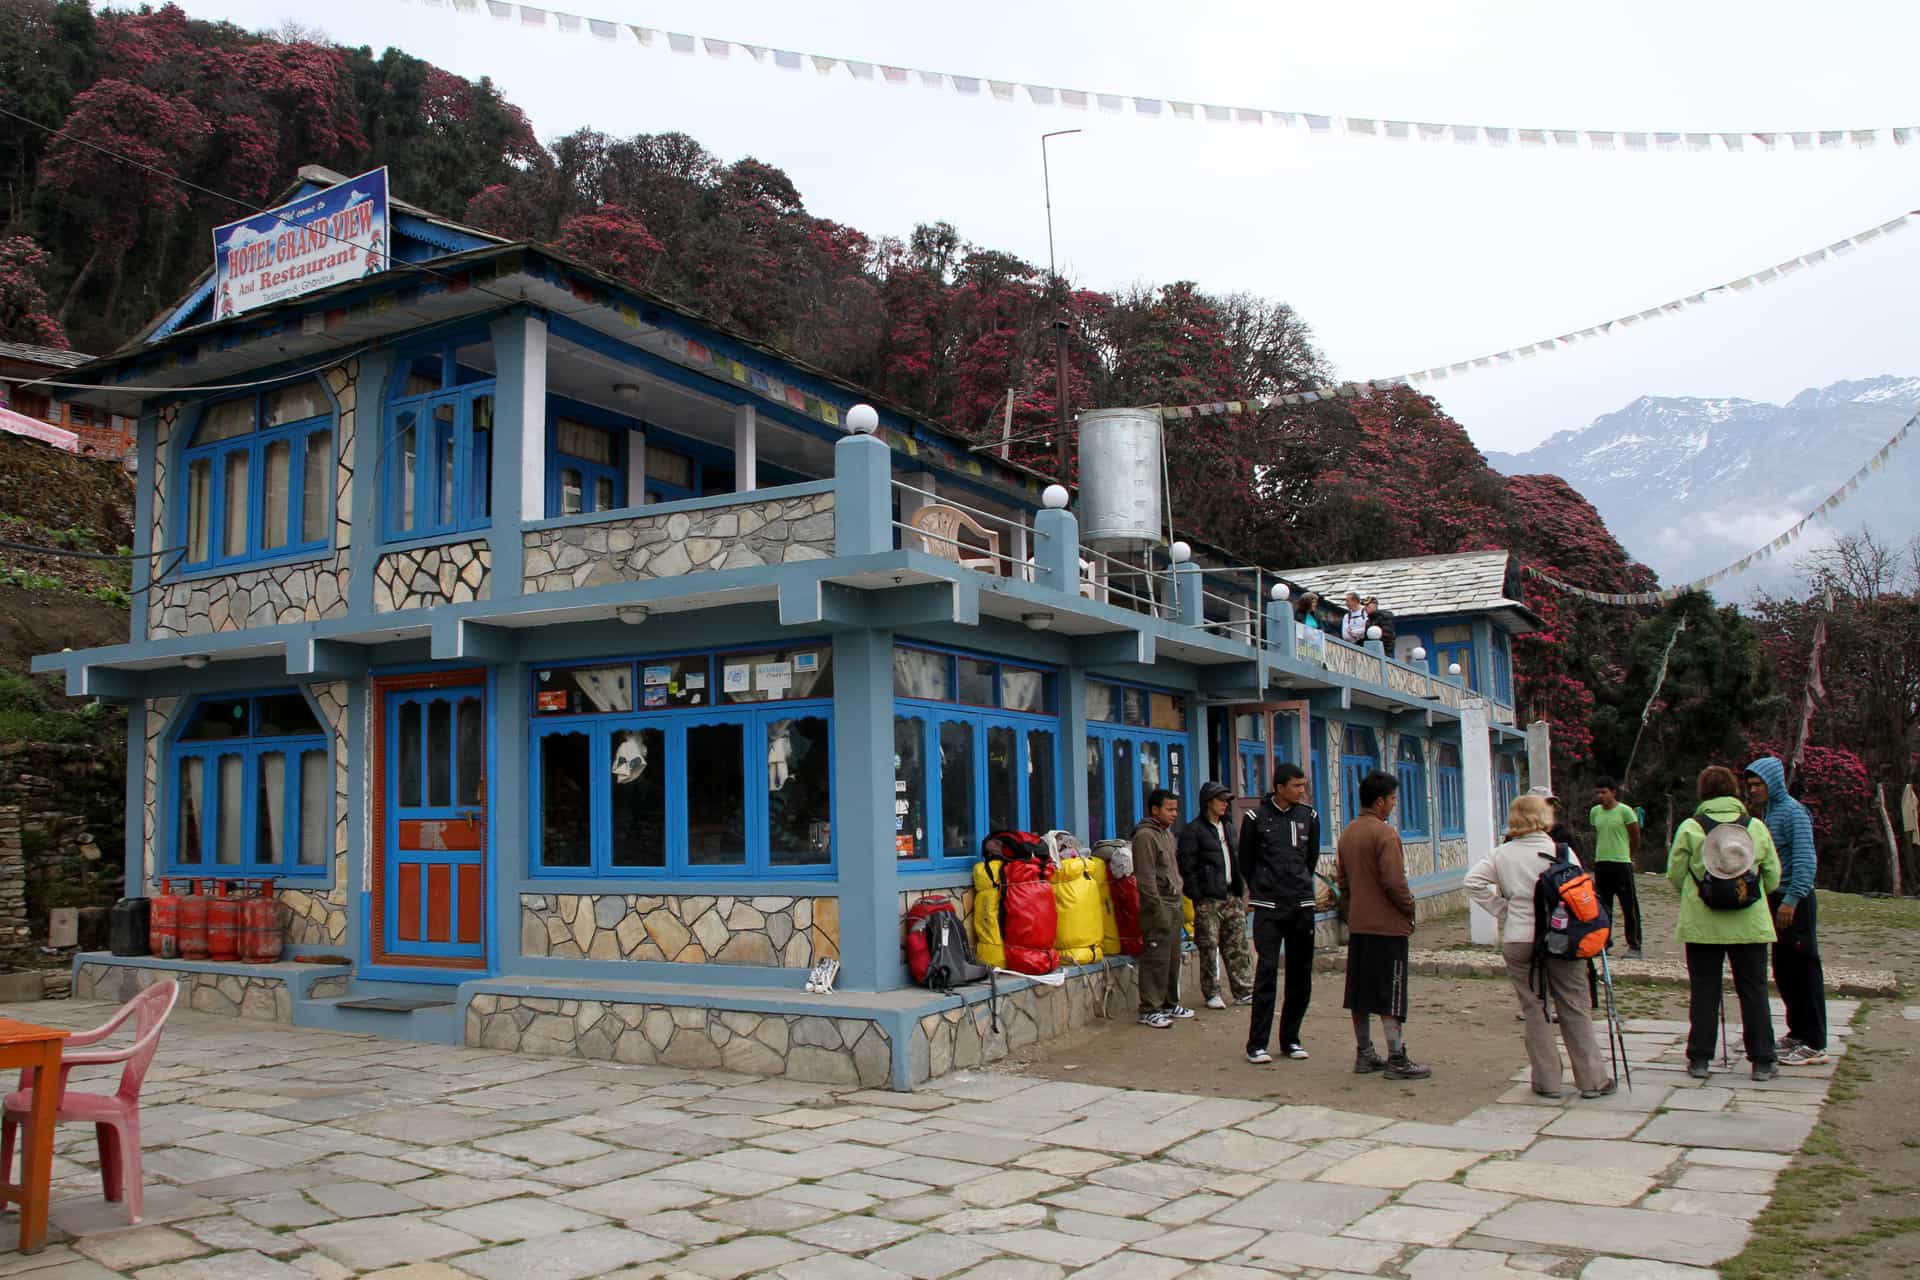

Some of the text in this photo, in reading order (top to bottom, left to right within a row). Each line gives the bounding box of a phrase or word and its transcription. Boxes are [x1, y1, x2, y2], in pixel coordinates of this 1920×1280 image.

[227, 199, 375, 280] HOTEL GRAND VIEW
[239, 279, 256, 297] And
[260, 245, 359, 290] Restaurant
